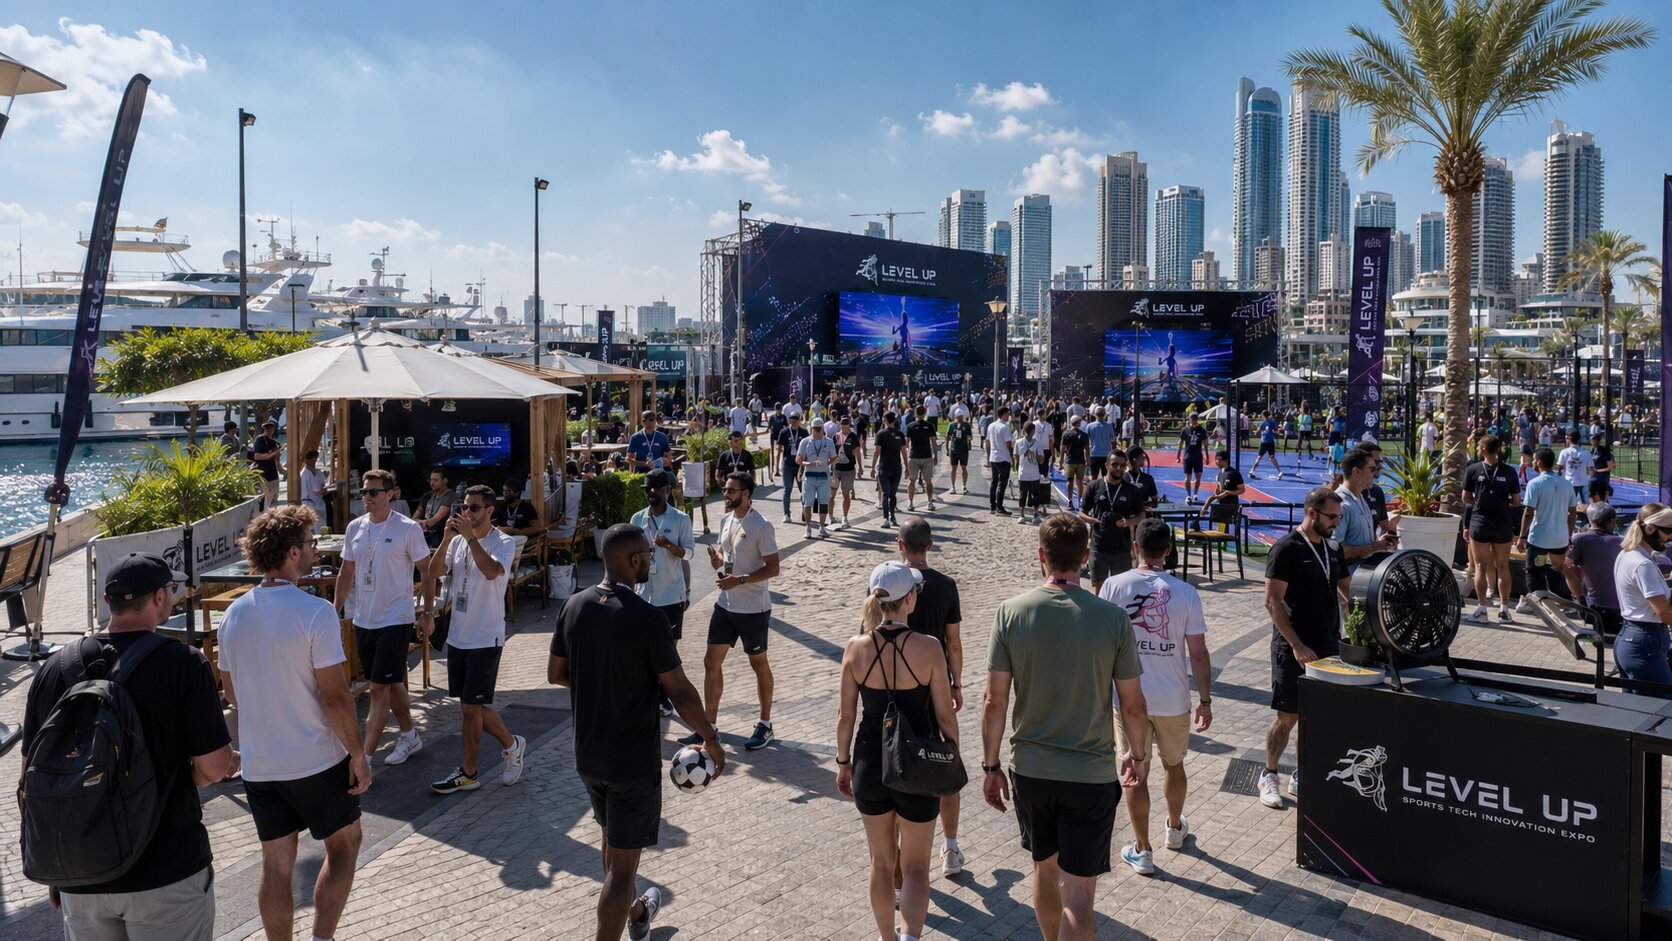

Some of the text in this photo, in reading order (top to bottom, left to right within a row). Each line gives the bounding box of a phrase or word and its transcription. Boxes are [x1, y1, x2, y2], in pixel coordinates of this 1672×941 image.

[881, 264, 936, 280] LEVEL UP
[1360, 255, 1375, 331] LEVEL UP
[1152, 303, 1205, 313] LEVEL UP
[671, 360, 685, 370] UP
[453, 436, 502, 445] LEVEL UP
[196, 535, 230, 564] LEVEL
[1159, 643, 1176, 652] UP
[1402, 766, 1598, 827] LEVEL UP
[1402, 796, 1596, 844] SPORTS TECH INNOVATION EXPO
